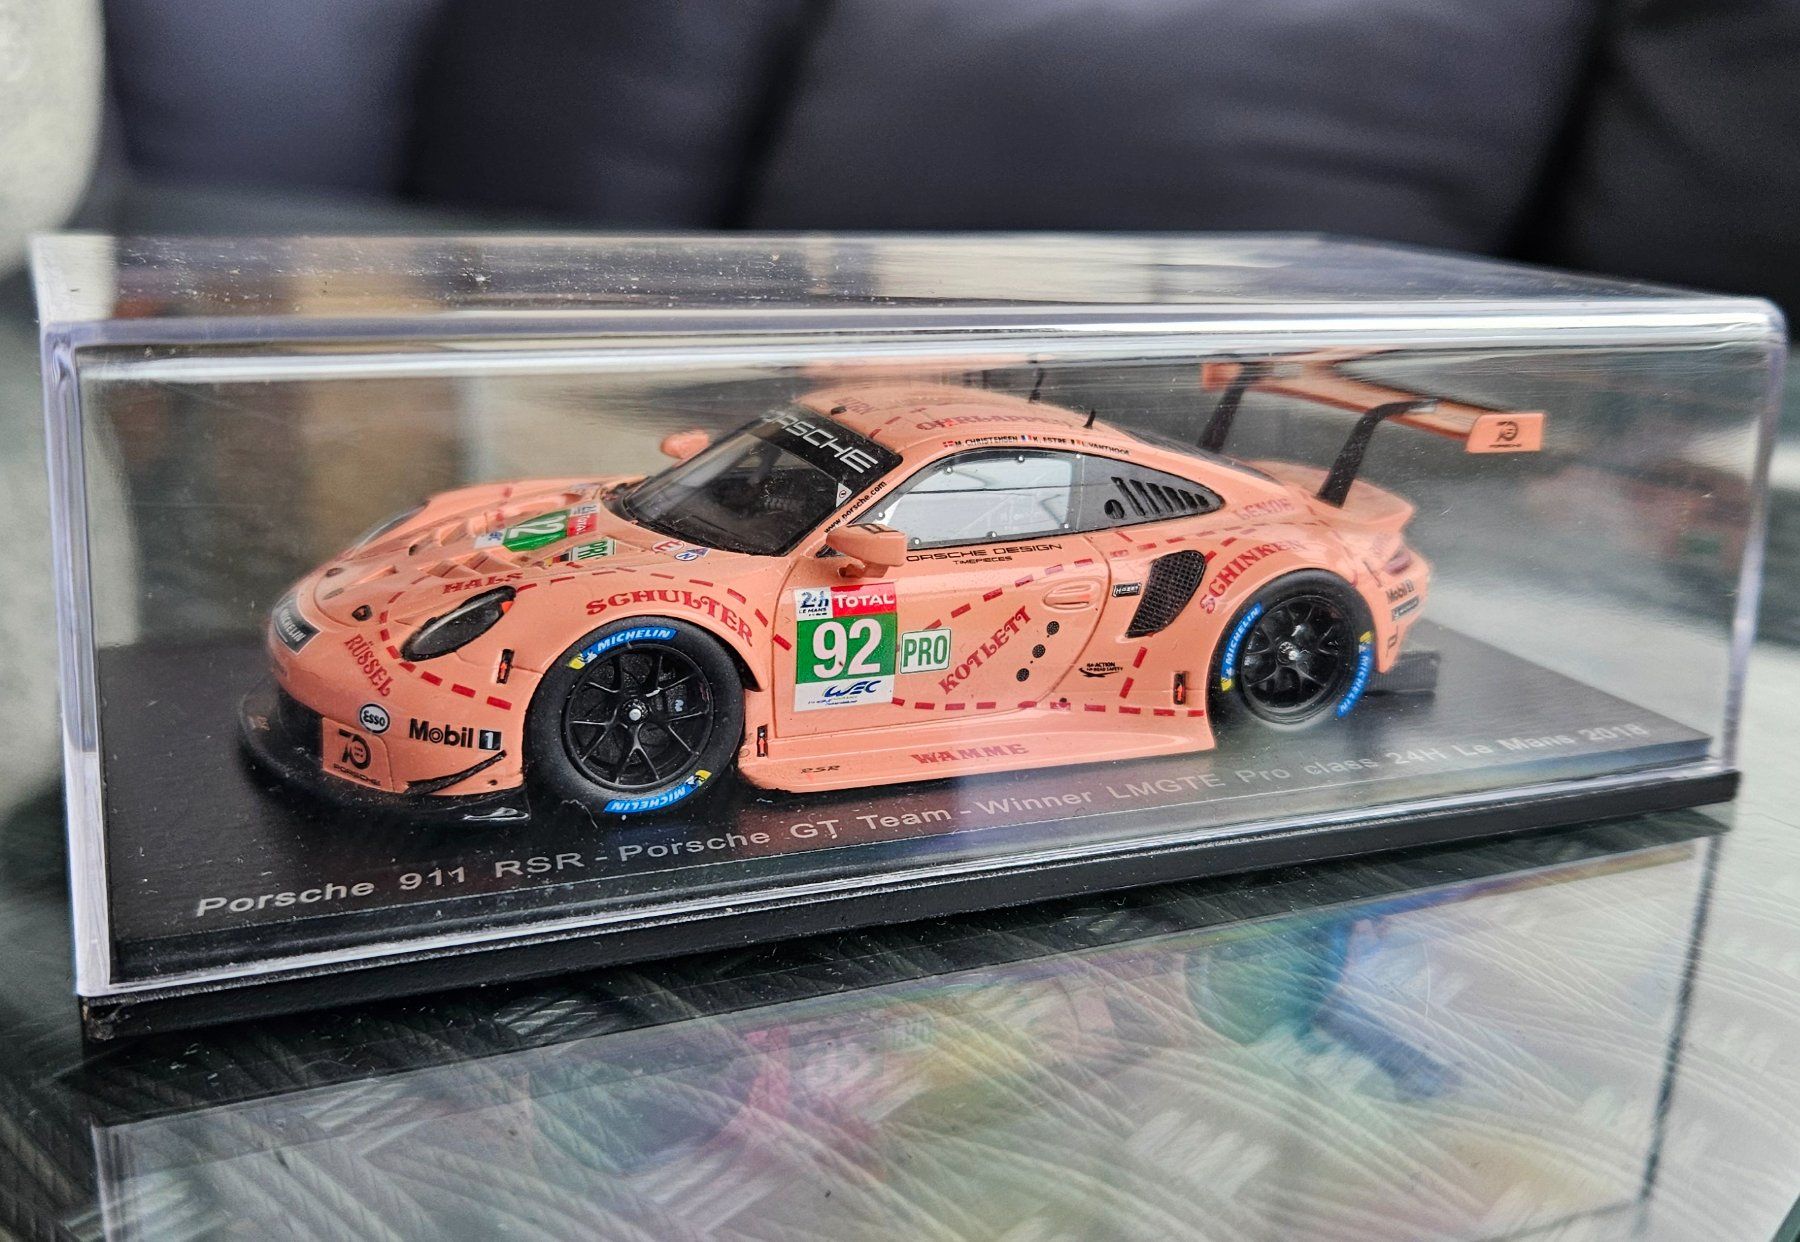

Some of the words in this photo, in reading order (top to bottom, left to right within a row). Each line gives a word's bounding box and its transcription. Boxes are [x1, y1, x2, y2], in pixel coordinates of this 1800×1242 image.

[823, 481, 887, 534] www.porsche.com
[906, 549, 988, 562] ORSCHE
[992, 544, 1063, 555] DESIGN
[952, 556, 1013, 565] TIMEPIECES
[442, 573, 524, 594] HALS
[833, 594, 896, 609] TOTAL
[585, 589, 754, 647] SCHULTER
[596, 628, 671, 652] MICHELIN
[812, 618, 882, 679] 92
[1225, 606, 1260, 666] MICHELIN
[903, 635, 948, 667] PRO
[343, 633, 391, 697] RÜSSEL
[824, 680, 882, 698] WEC
[408, 718, 474, 748] Mobil
[911, 743, 1030, 765] WAMME
[611, 787, 687, 811] MICHELIN
[195, 880, 375, 917] Porsche
[399, 864, 465, 892] 911
[494, 852, 583, 879] RSR
[618, 829, 771, 863] Porsche
[790, 820, 839, 840] GT
[856, 810, 951, 831] Team
[1106, 773, 1227, 799] LMGTE
[1235, 765, 1291, 784] Pro
[1303, 754, 1379, 776] class
[1388, 745, 1448, 767] 24H
[1455, 742, 1494, 758] Le
[1496, 734, 1577, 753] Mans
[1579, 722, 1652, 742] 2018
